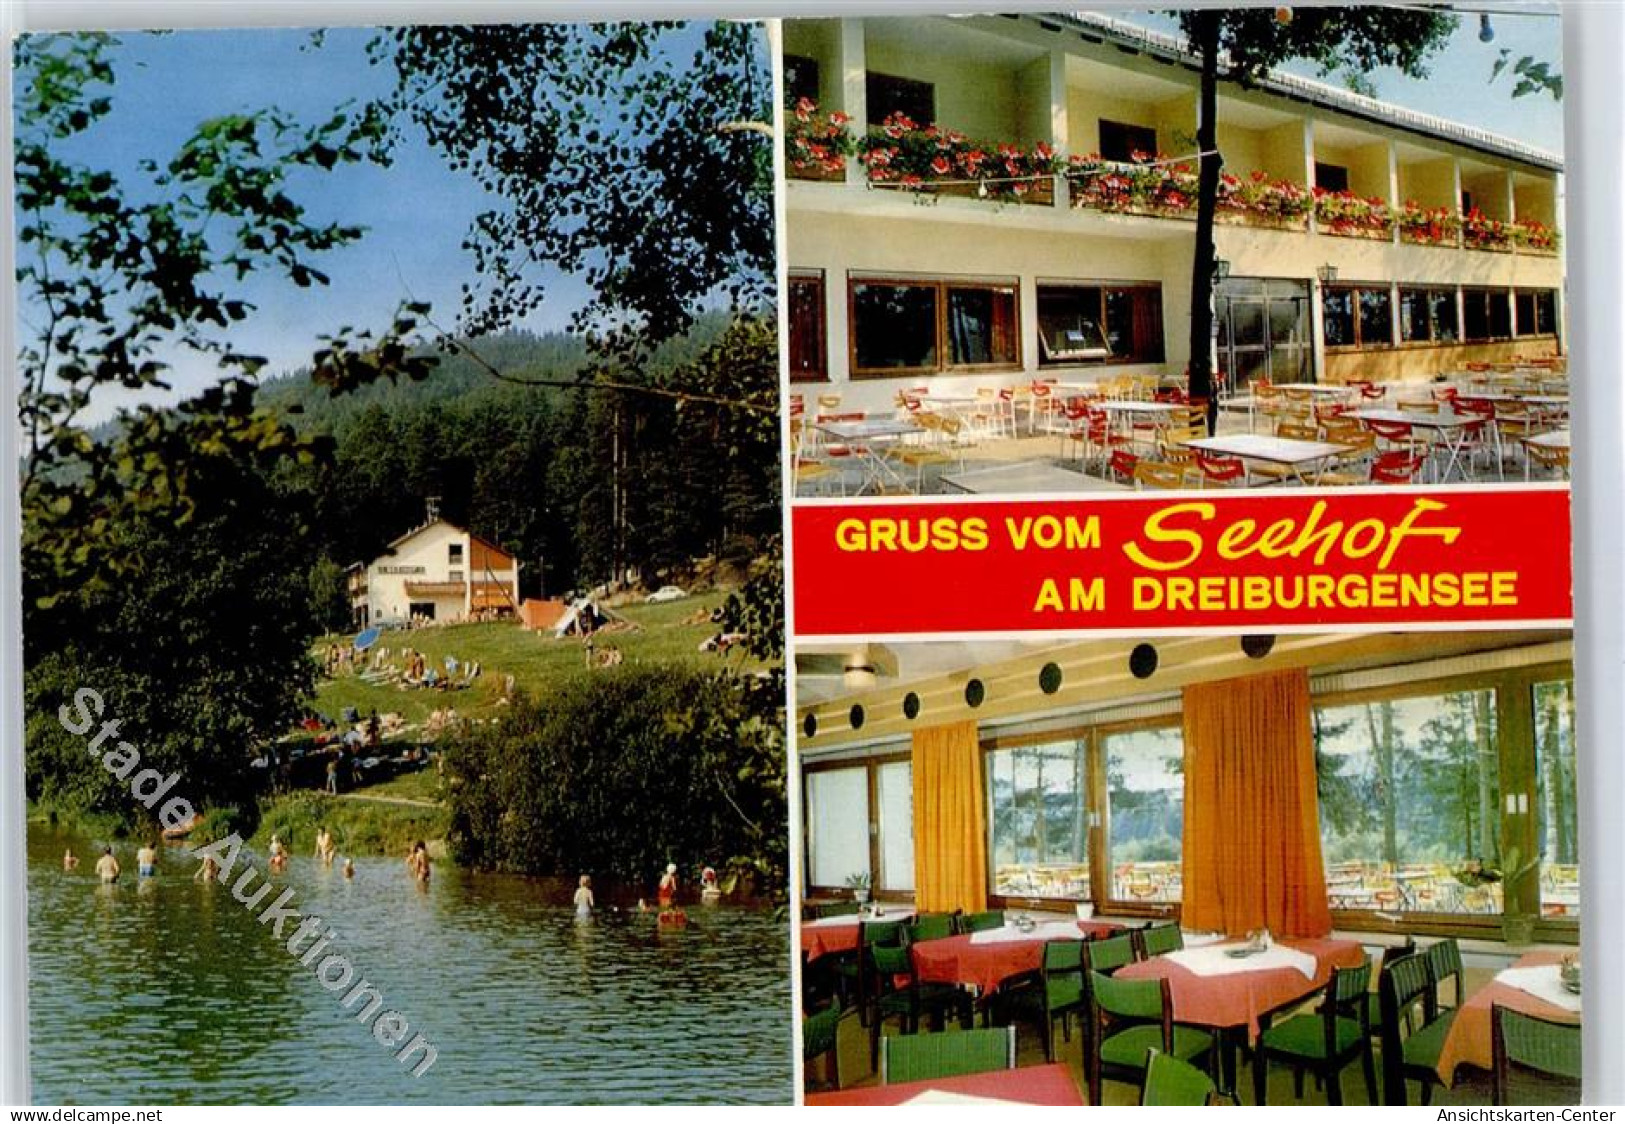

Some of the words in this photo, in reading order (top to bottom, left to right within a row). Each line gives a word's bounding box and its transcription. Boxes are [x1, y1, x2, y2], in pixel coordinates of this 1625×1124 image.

[835, 518, 989, 553] GRUSS
[1005, 515, 1101, 551] VOM
[1122, 498, 1461, 572] Seehof
[1034, 577, 1106, 612] AM
[1132, 570, 1518, 612] DREIBURGENSEE
